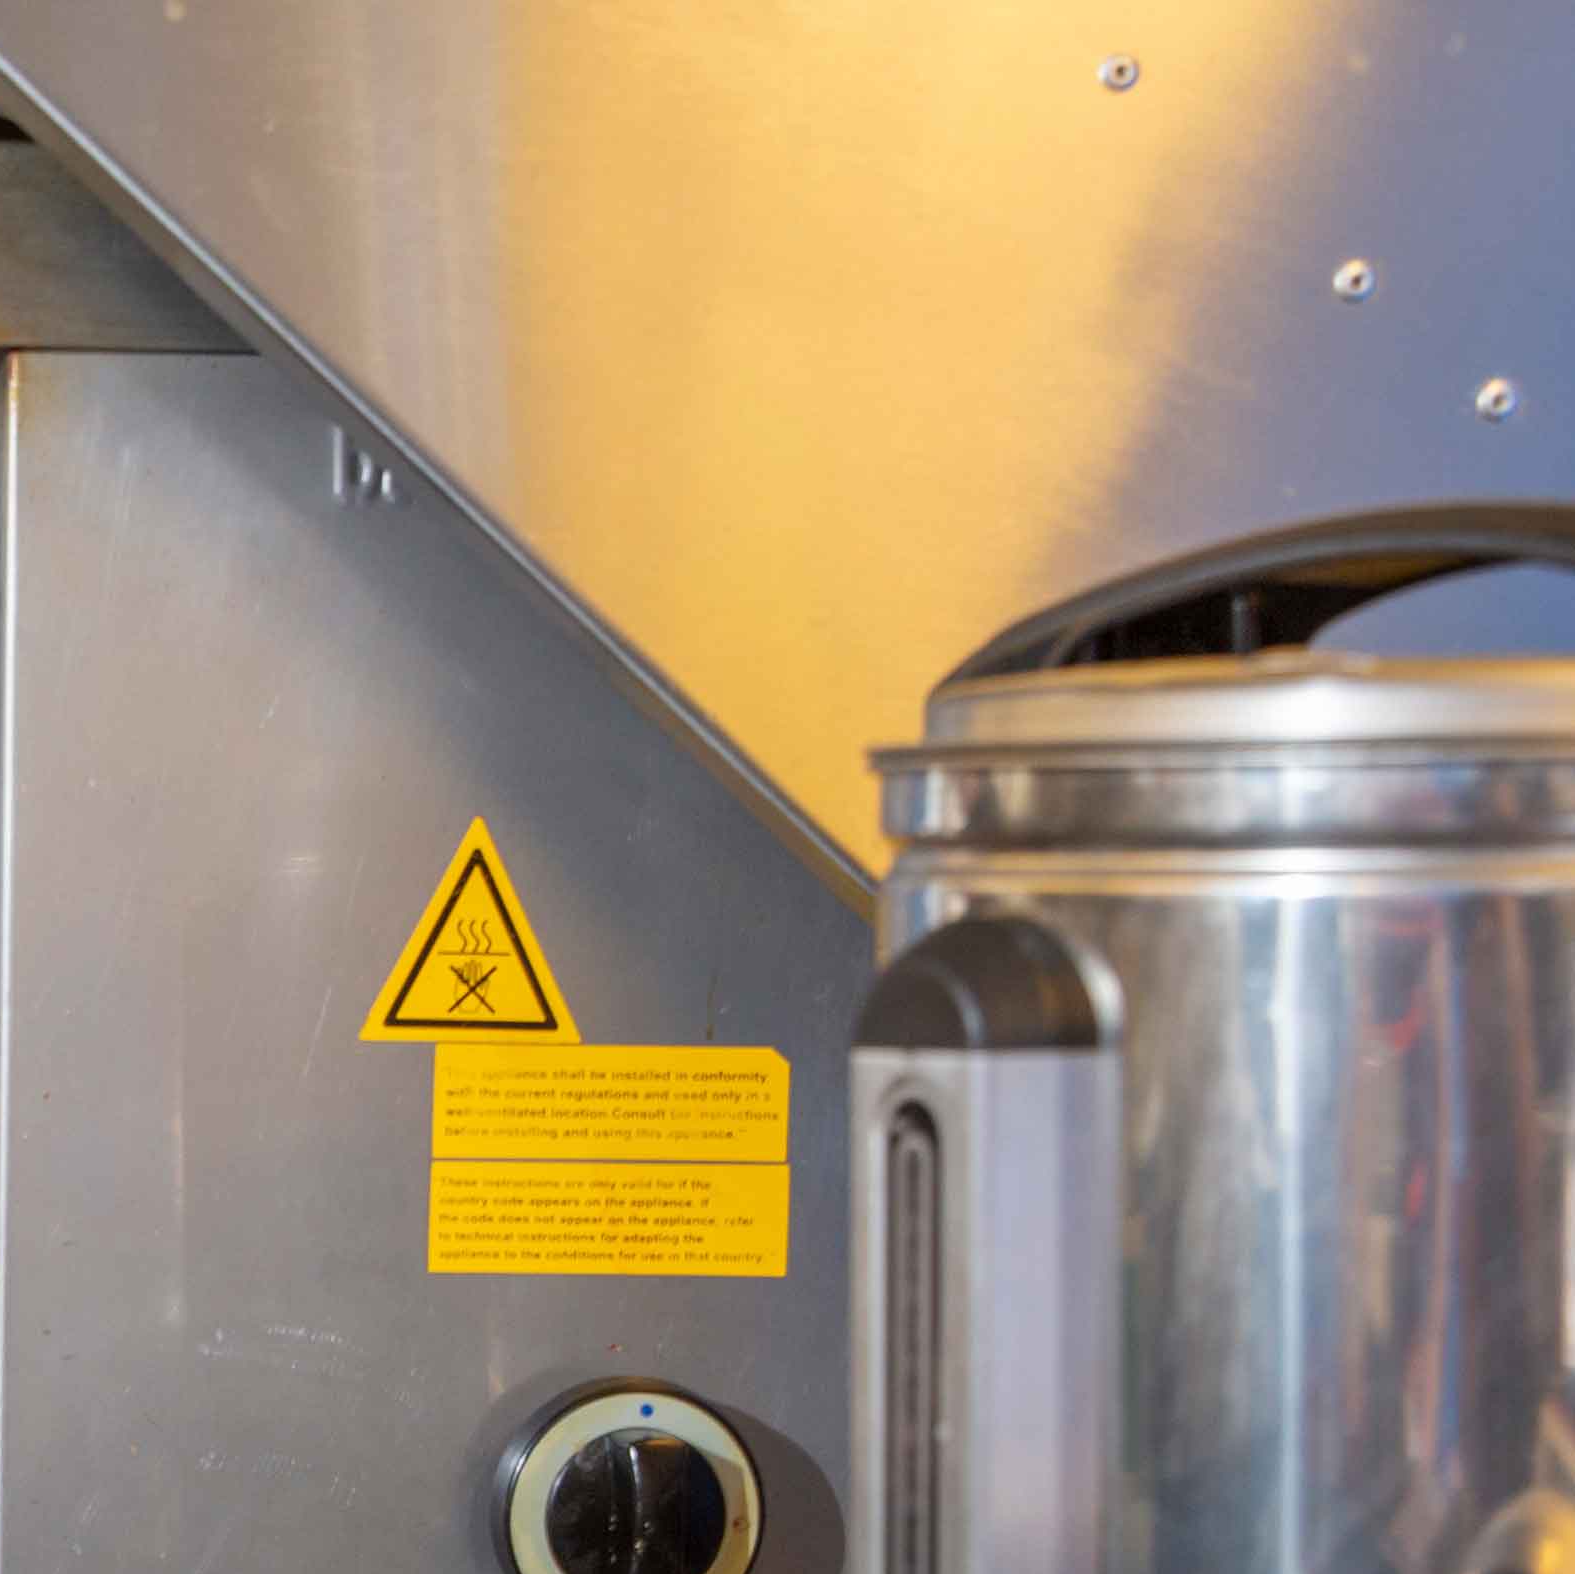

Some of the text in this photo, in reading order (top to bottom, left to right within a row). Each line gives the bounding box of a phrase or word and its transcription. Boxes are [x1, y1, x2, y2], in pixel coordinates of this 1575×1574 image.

[611, 1070, 671, 1081] installed
[691, 1070, 768, 1085] conformity
[504, 1087, 556, 1099] current
[560, 1088, 639, 1102] regulations
[644, 1090, 669, 1101] and
[711, 1089, 741, 1104] only
[562, 1127, 589, 1138] and
[592, 1129, 632, 1141] using
[529, 1197, 580, 1208] appears
[604, 1196, 626, 1207] the
[463, 1214, 494, 1225] code
[498, 1214, 530, 1225] does
[534, 1214, 556, 1225] not
[559, 1216, 604, 1226] appear
[627, 1215, 649, 1225] the
[600, 1233, 618, 1243] for
[683, 1234, 705, 1244] the
[618, 1250, 637, 1261] for
